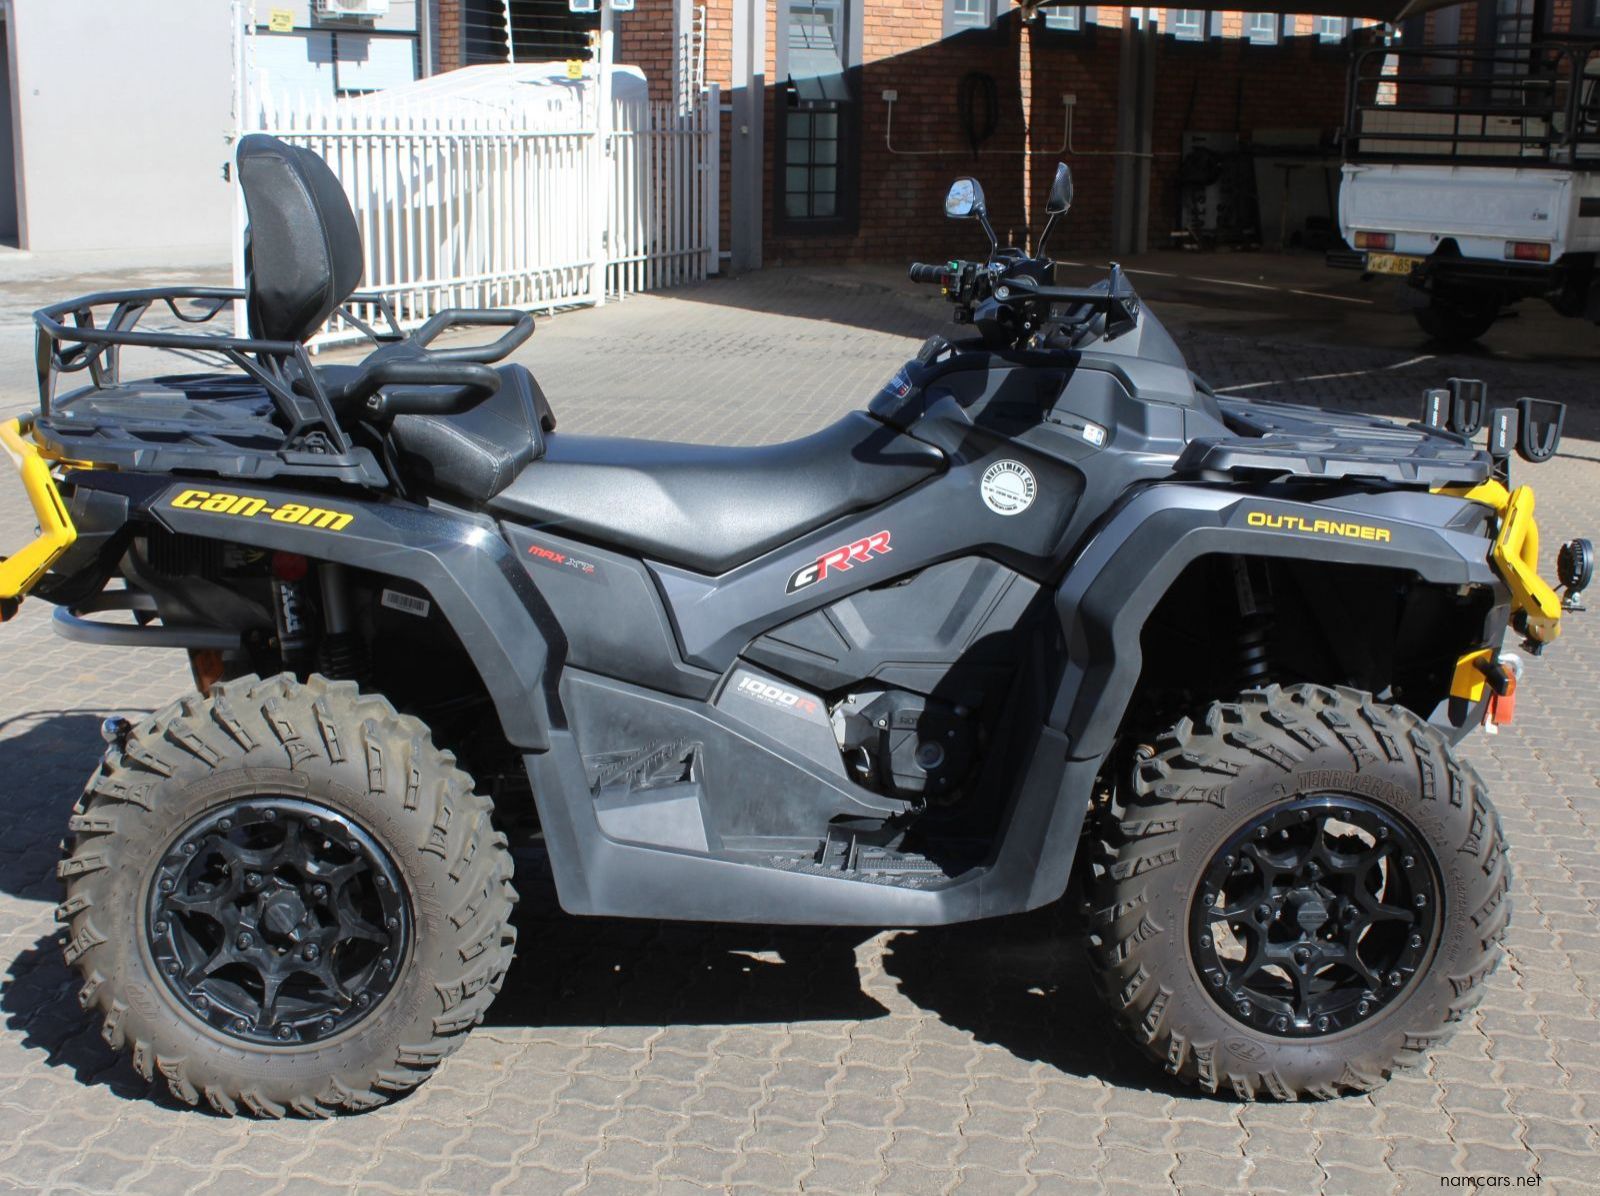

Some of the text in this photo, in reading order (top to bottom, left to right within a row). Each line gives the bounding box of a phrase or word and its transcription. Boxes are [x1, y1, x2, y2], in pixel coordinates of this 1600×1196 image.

[984, 463, 1026, 484] INVESTMENT
[1024, 477, 1034, 498] CARS
[170, 489, 355, 532] can-am
[1247, 511, 1392, 543] OUTLANDER
[527, 545, 567, 565] MAX
[784, 529, 894, 596] GRRR
[739, 676, 818, 716] 1000R
